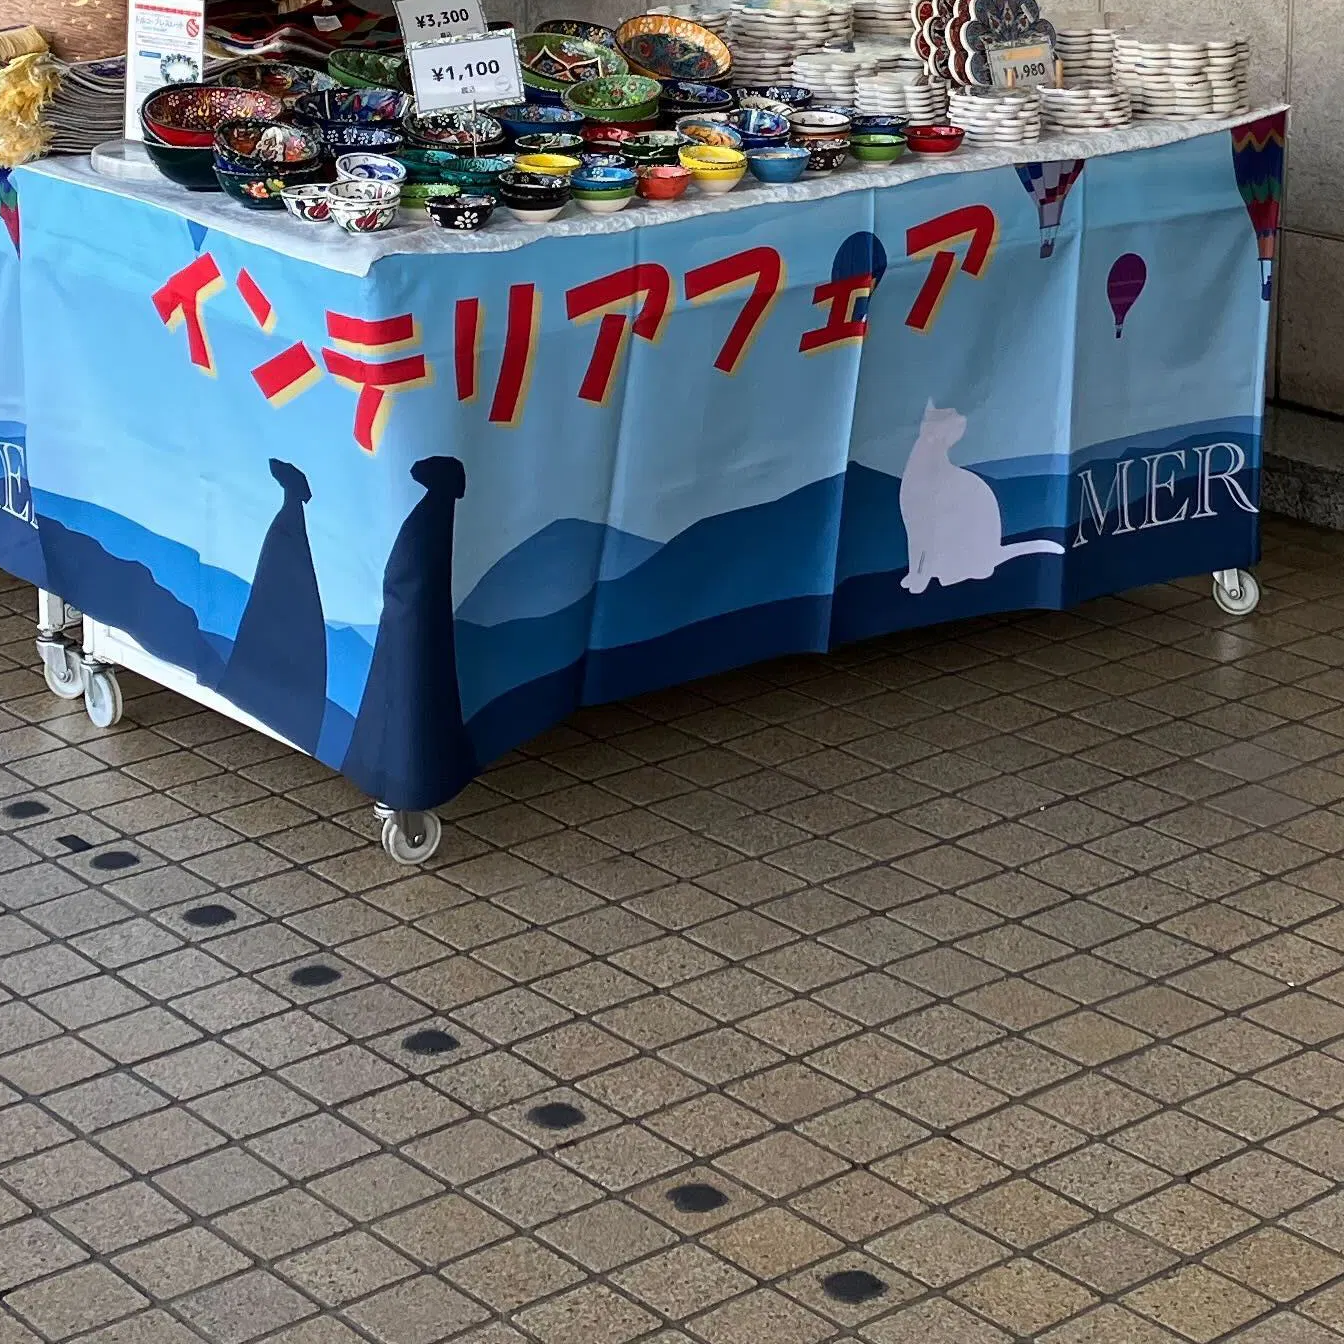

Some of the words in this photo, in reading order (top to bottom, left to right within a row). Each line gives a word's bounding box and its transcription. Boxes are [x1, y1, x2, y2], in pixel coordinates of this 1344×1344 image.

[414, 8, 470, 29] ¥3,300
[431, 59, 500, 82] ¥1,100
[151, 201, 999, 454] インテリアフェア
[1073, 440, 1261, 548] MER
